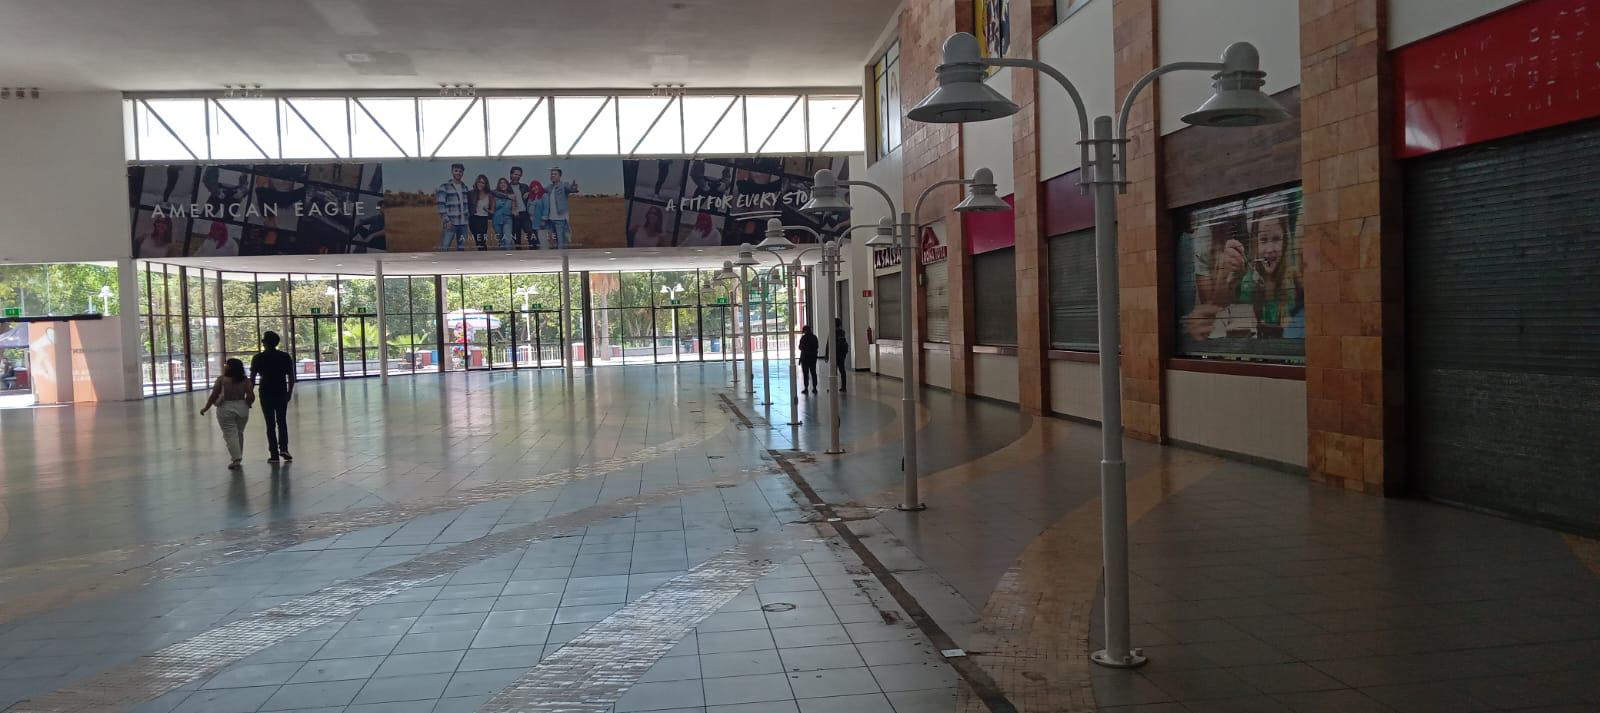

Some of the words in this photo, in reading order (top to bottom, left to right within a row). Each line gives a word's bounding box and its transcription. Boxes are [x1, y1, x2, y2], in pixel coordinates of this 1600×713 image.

[152, 203, 278, 219] AMERICAN
[295, 201, 365, 217] EAGLE
[665, 198, 677, 211] A
[680, 195, 707, 211] FIT
[707, 194, 733, 210] FOR
[458, 233, 517, 242] AMERICAN
